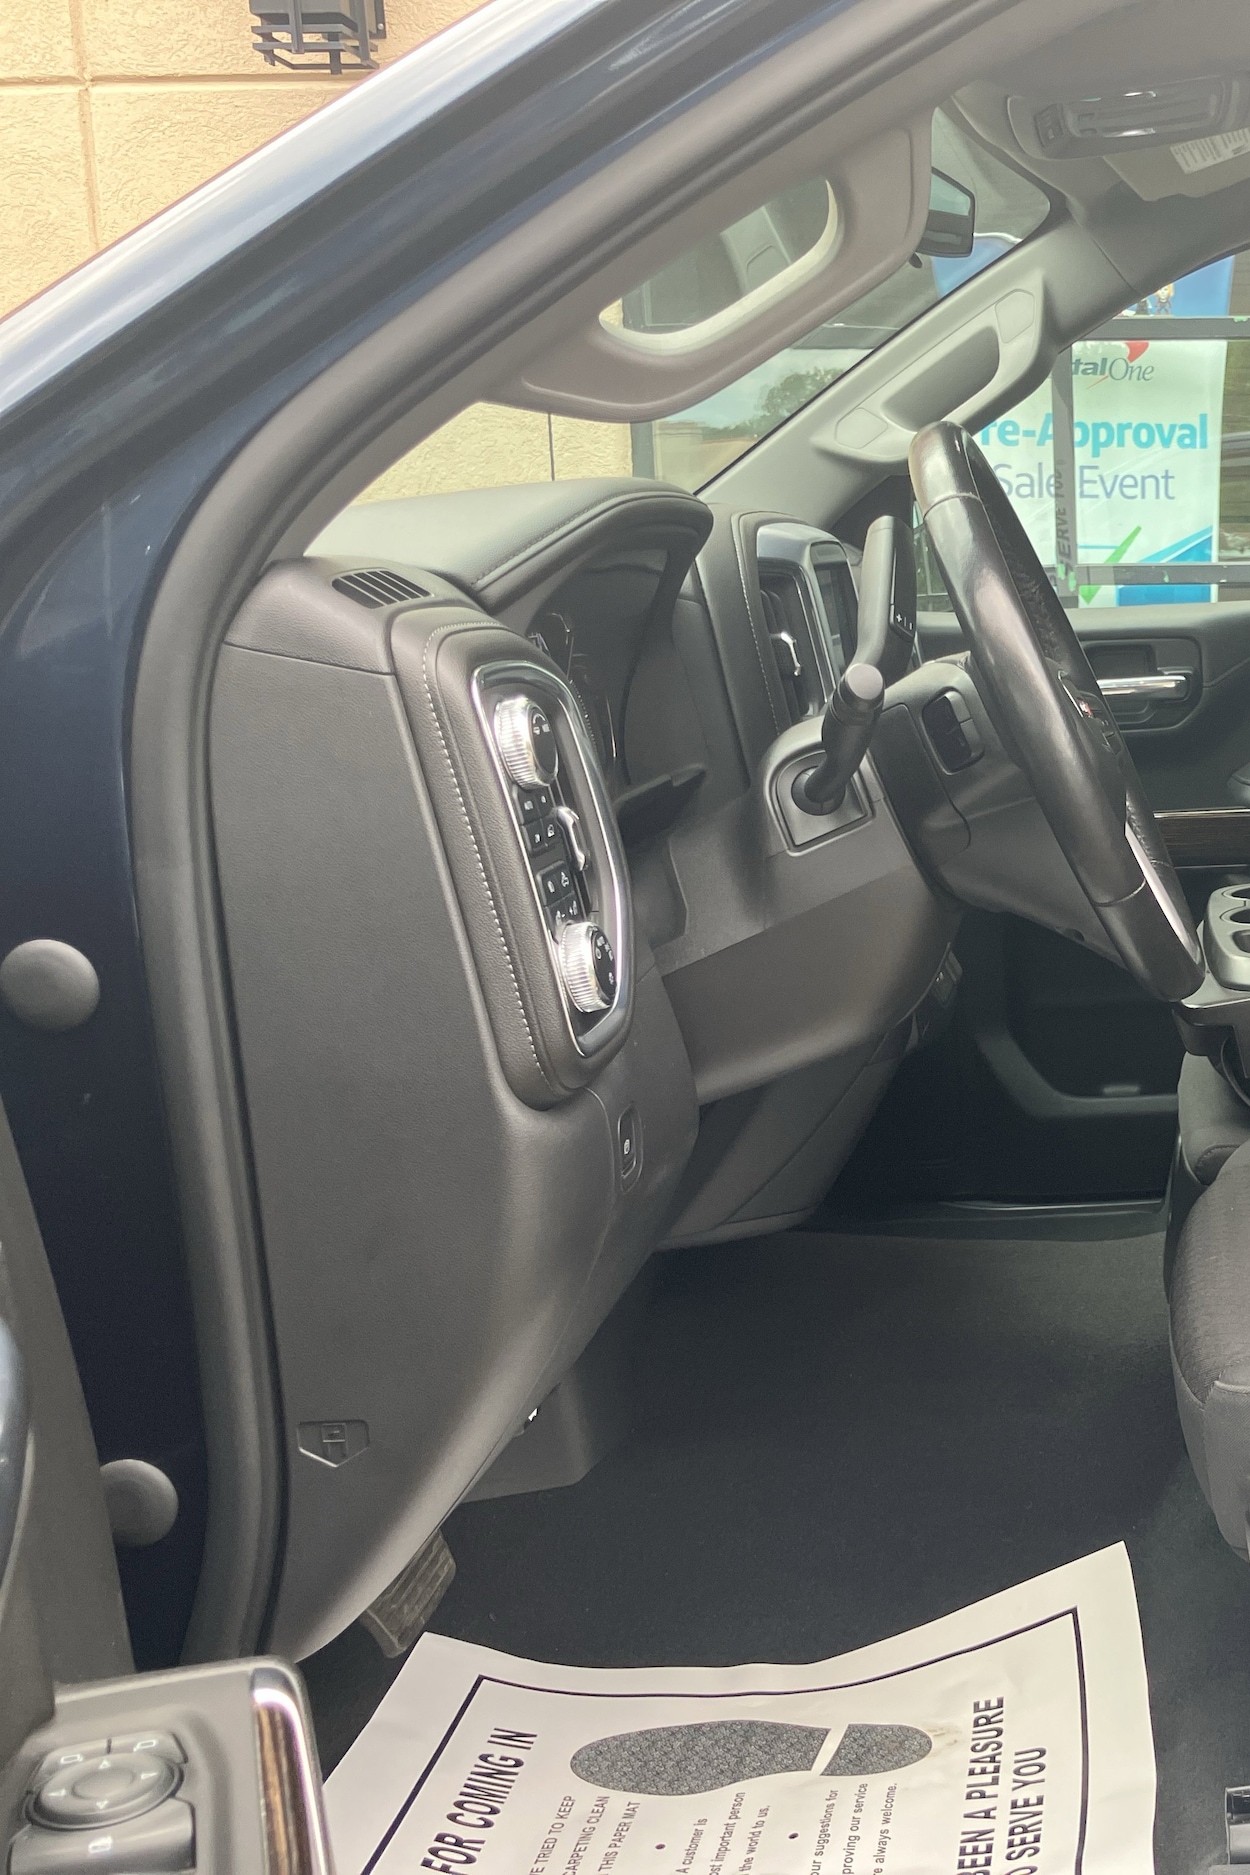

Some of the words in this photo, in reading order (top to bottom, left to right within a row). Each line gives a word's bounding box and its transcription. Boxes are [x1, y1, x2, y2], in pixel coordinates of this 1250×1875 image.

[993, 462, 1055, 498] Sale
[1078, 465, 1175, 499] Event
[487, 1727, 538, 1750] IN
[964, 1696, 1004, 1800] PLEASURE
[1011, 1747, 1047, 1792] YOU
[446, 1753, 524, 1829] COMING
[825, 1789, 839, 1802] for
[854, 1783, 868, 1813] service
[881, 1782, 898, 1825] welcome.
[555, 1795, 576, 1819] KEEP
[622, 1801, 641, 1823] MAT
[728, 1792, 746, 1820] person
[757, 1805, 771, 1818] us.
[963, 1806, 998, 1820] A
[549, 1822, 565, 1835] TO
[562, 1826, 596, 1875] CARPETING
[586, 1796, 610, 1824] CLEAN
[608, 1820, 632, 1849] PAPER
[752, 1820, 765, 1830] to
[814, 1802, 836, 1857] suggestions
[850, 1816, 861, 1831] our
[1005, 1794, 1044, 1861] SERVE
[420, 1832, 486, 1875] FOR
[534, 1837, 558, 1865] TRIED
[682, 1828, 704, 1866] customer
[693, 1818, 707, 1826] is
[711, 1822, 736, 1862] important
[746, 1831, 762, 1855] world
[842, 1835, 861, 1875] proving
[873, 1828, 892, 1864] always
[956, 1828, 995, 1875] BEEN
[598, 1851, 619, 1872] THIS
[709, 1863, 722, 1875] ost
[738, 1857, 754, 1872] the
[810, 1859, 822, 1875] our
